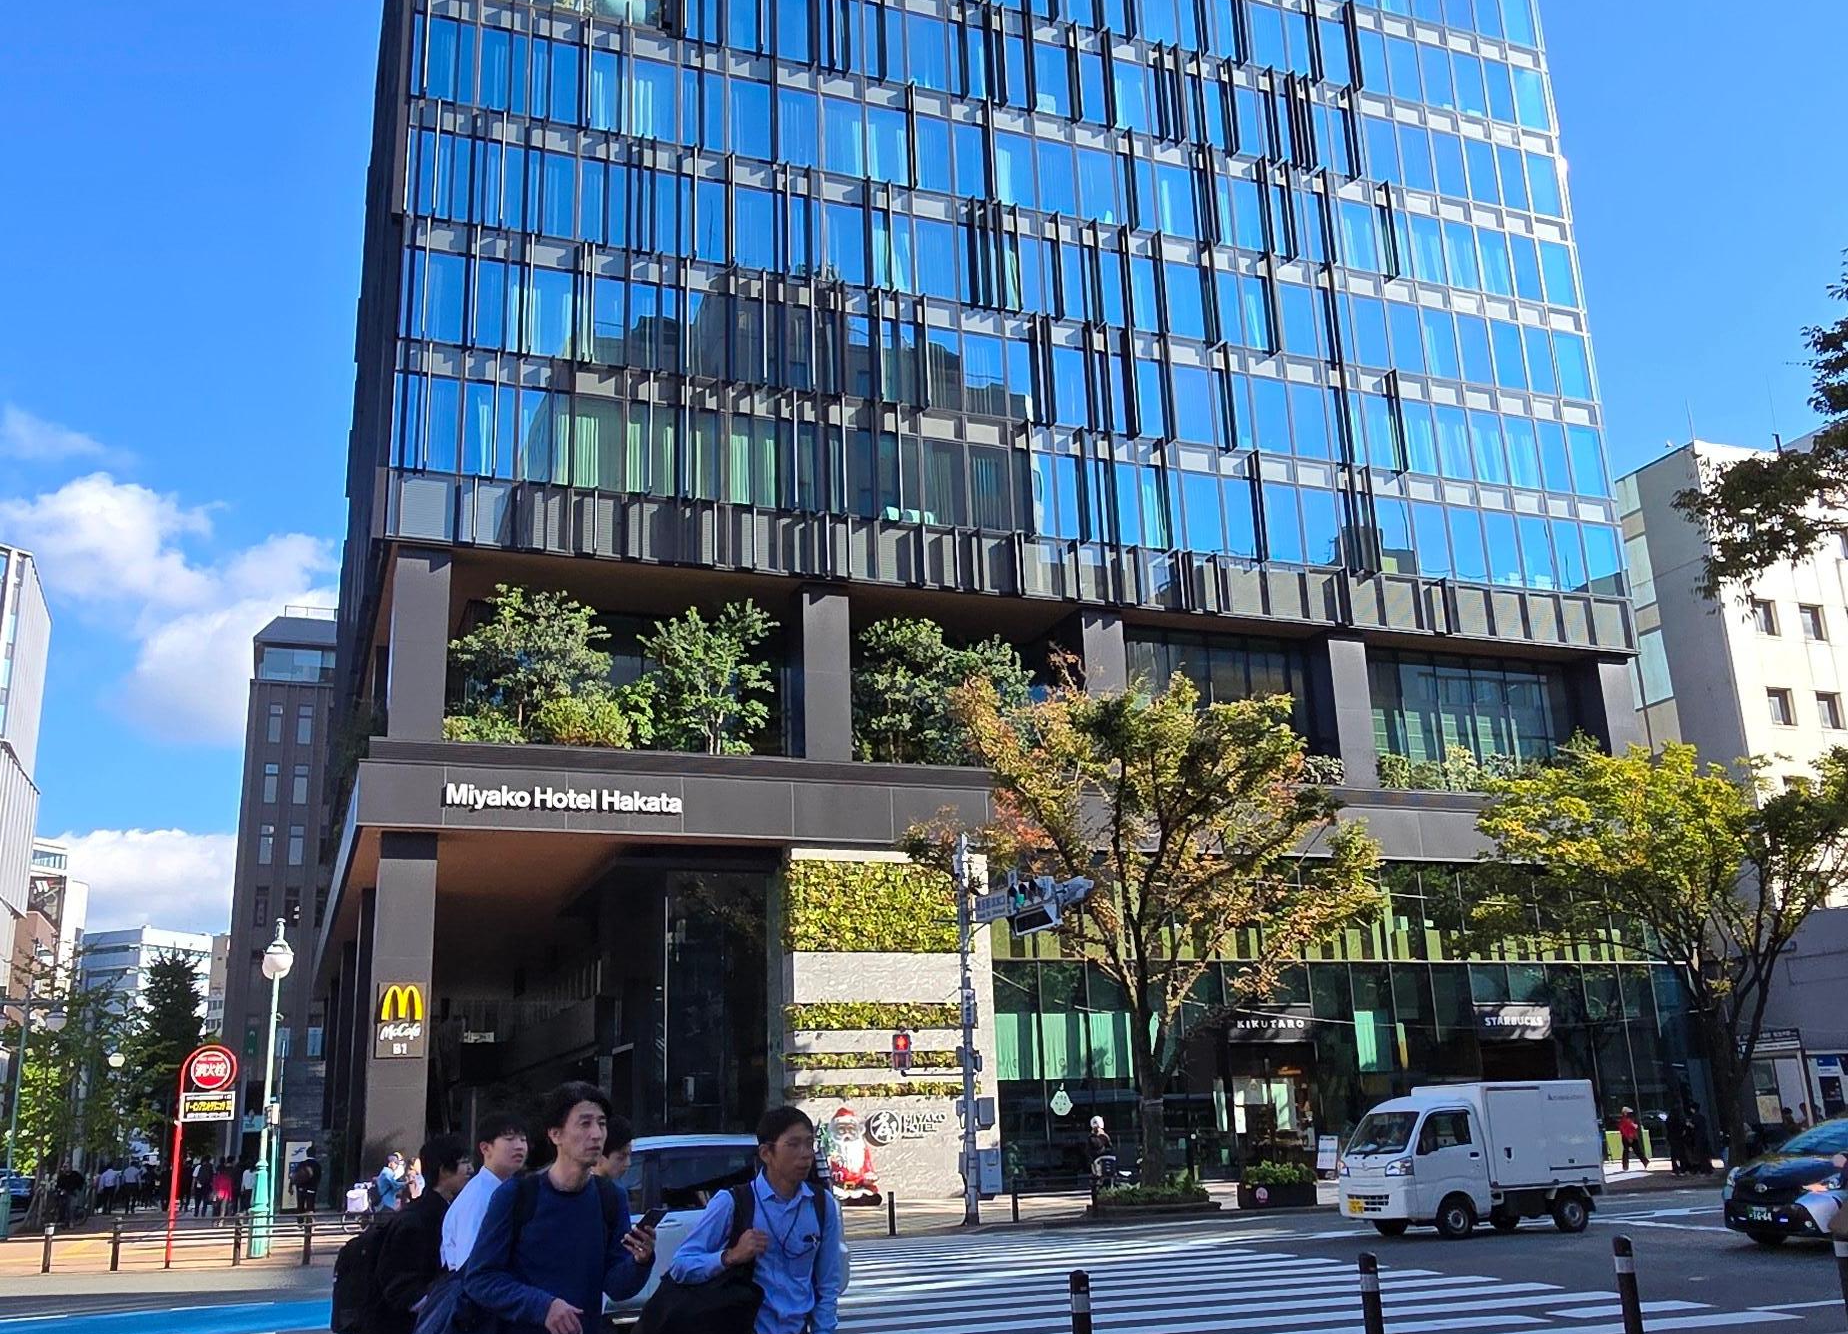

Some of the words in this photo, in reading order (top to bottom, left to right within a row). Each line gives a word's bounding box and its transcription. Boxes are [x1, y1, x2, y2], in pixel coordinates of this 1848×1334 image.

[446, 783, 531, 809] Miyako
[534, 786, 597, 810] Hotel
[601, 789, 683, 814] Hakata
[1236, 1019, 1305, 1029] KIKUTARO
[1484, 1016, 1543, 1027] STARBUCKS
[392, 1042, 407, 1055] B1
[901, 1113, 946, 1124] MIYAKO
[901, 1123, 937, 1133] HOTEL
